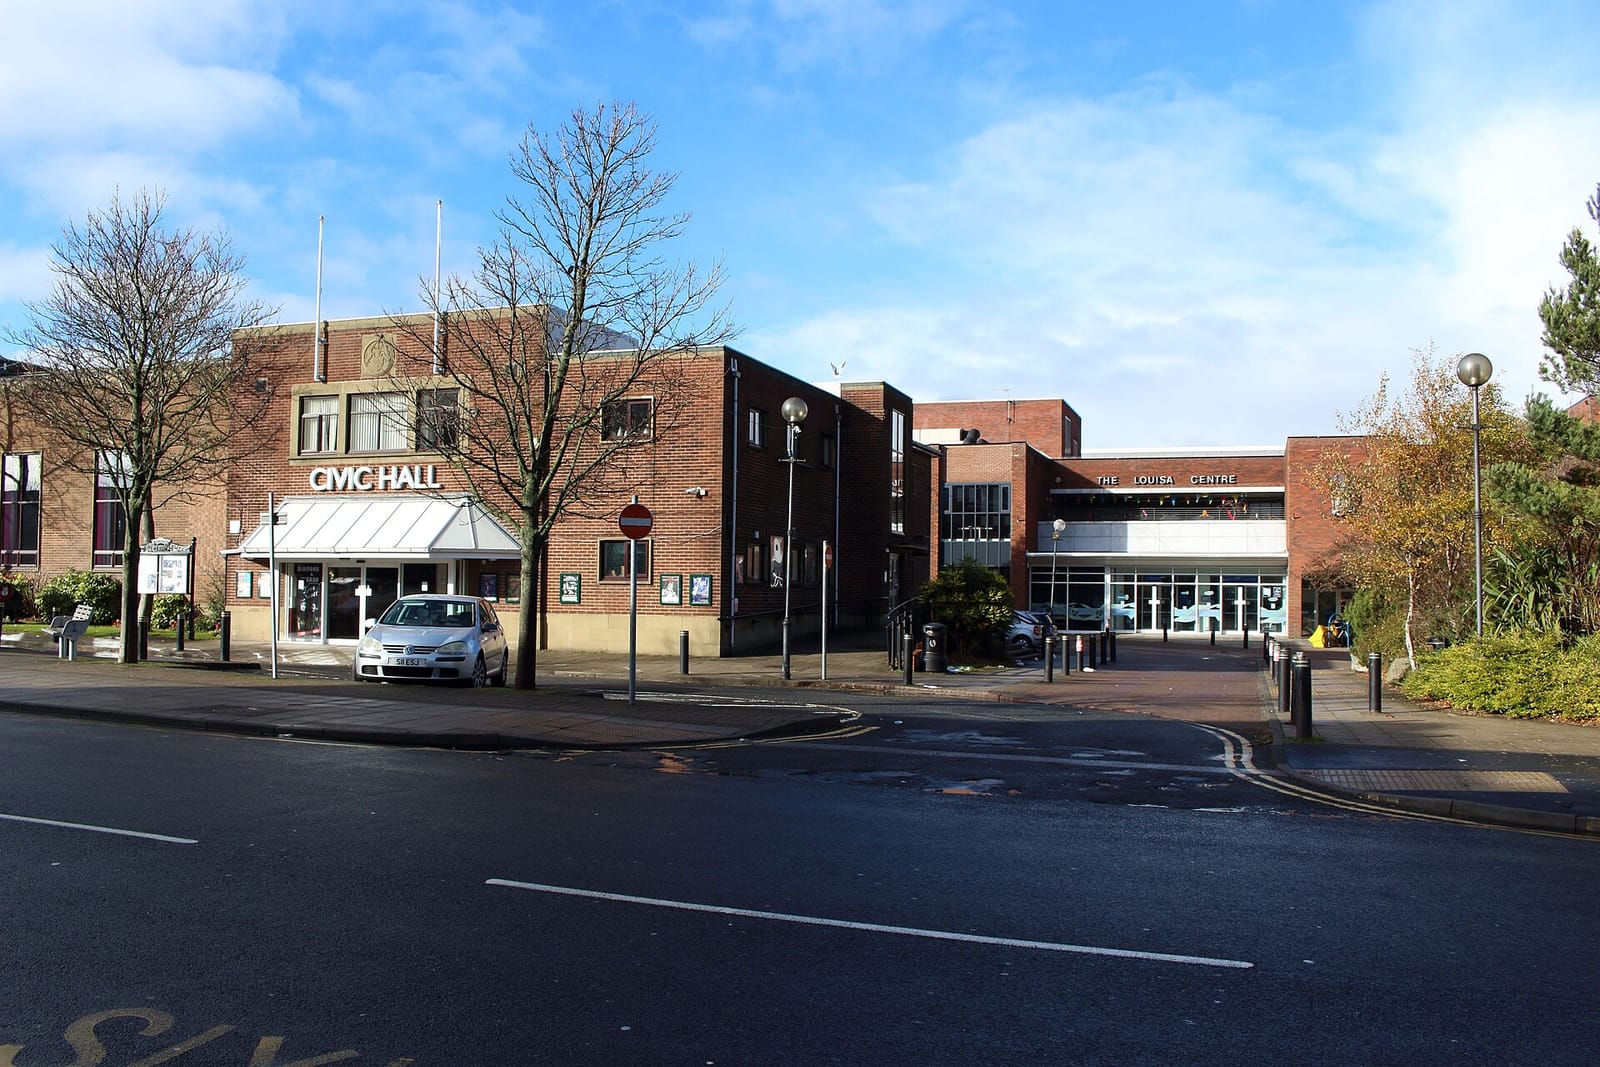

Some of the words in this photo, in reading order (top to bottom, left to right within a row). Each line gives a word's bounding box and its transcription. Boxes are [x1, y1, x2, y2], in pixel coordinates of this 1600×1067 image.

[309, 466, 375, 491] CIVIC
[378, 464, 443, 490] HALL
[1096, 476, 1118, 485] THE
[1133, 475, 1175, 485] LOUISA
[1190, 474, 1237, 484] CENTRE
